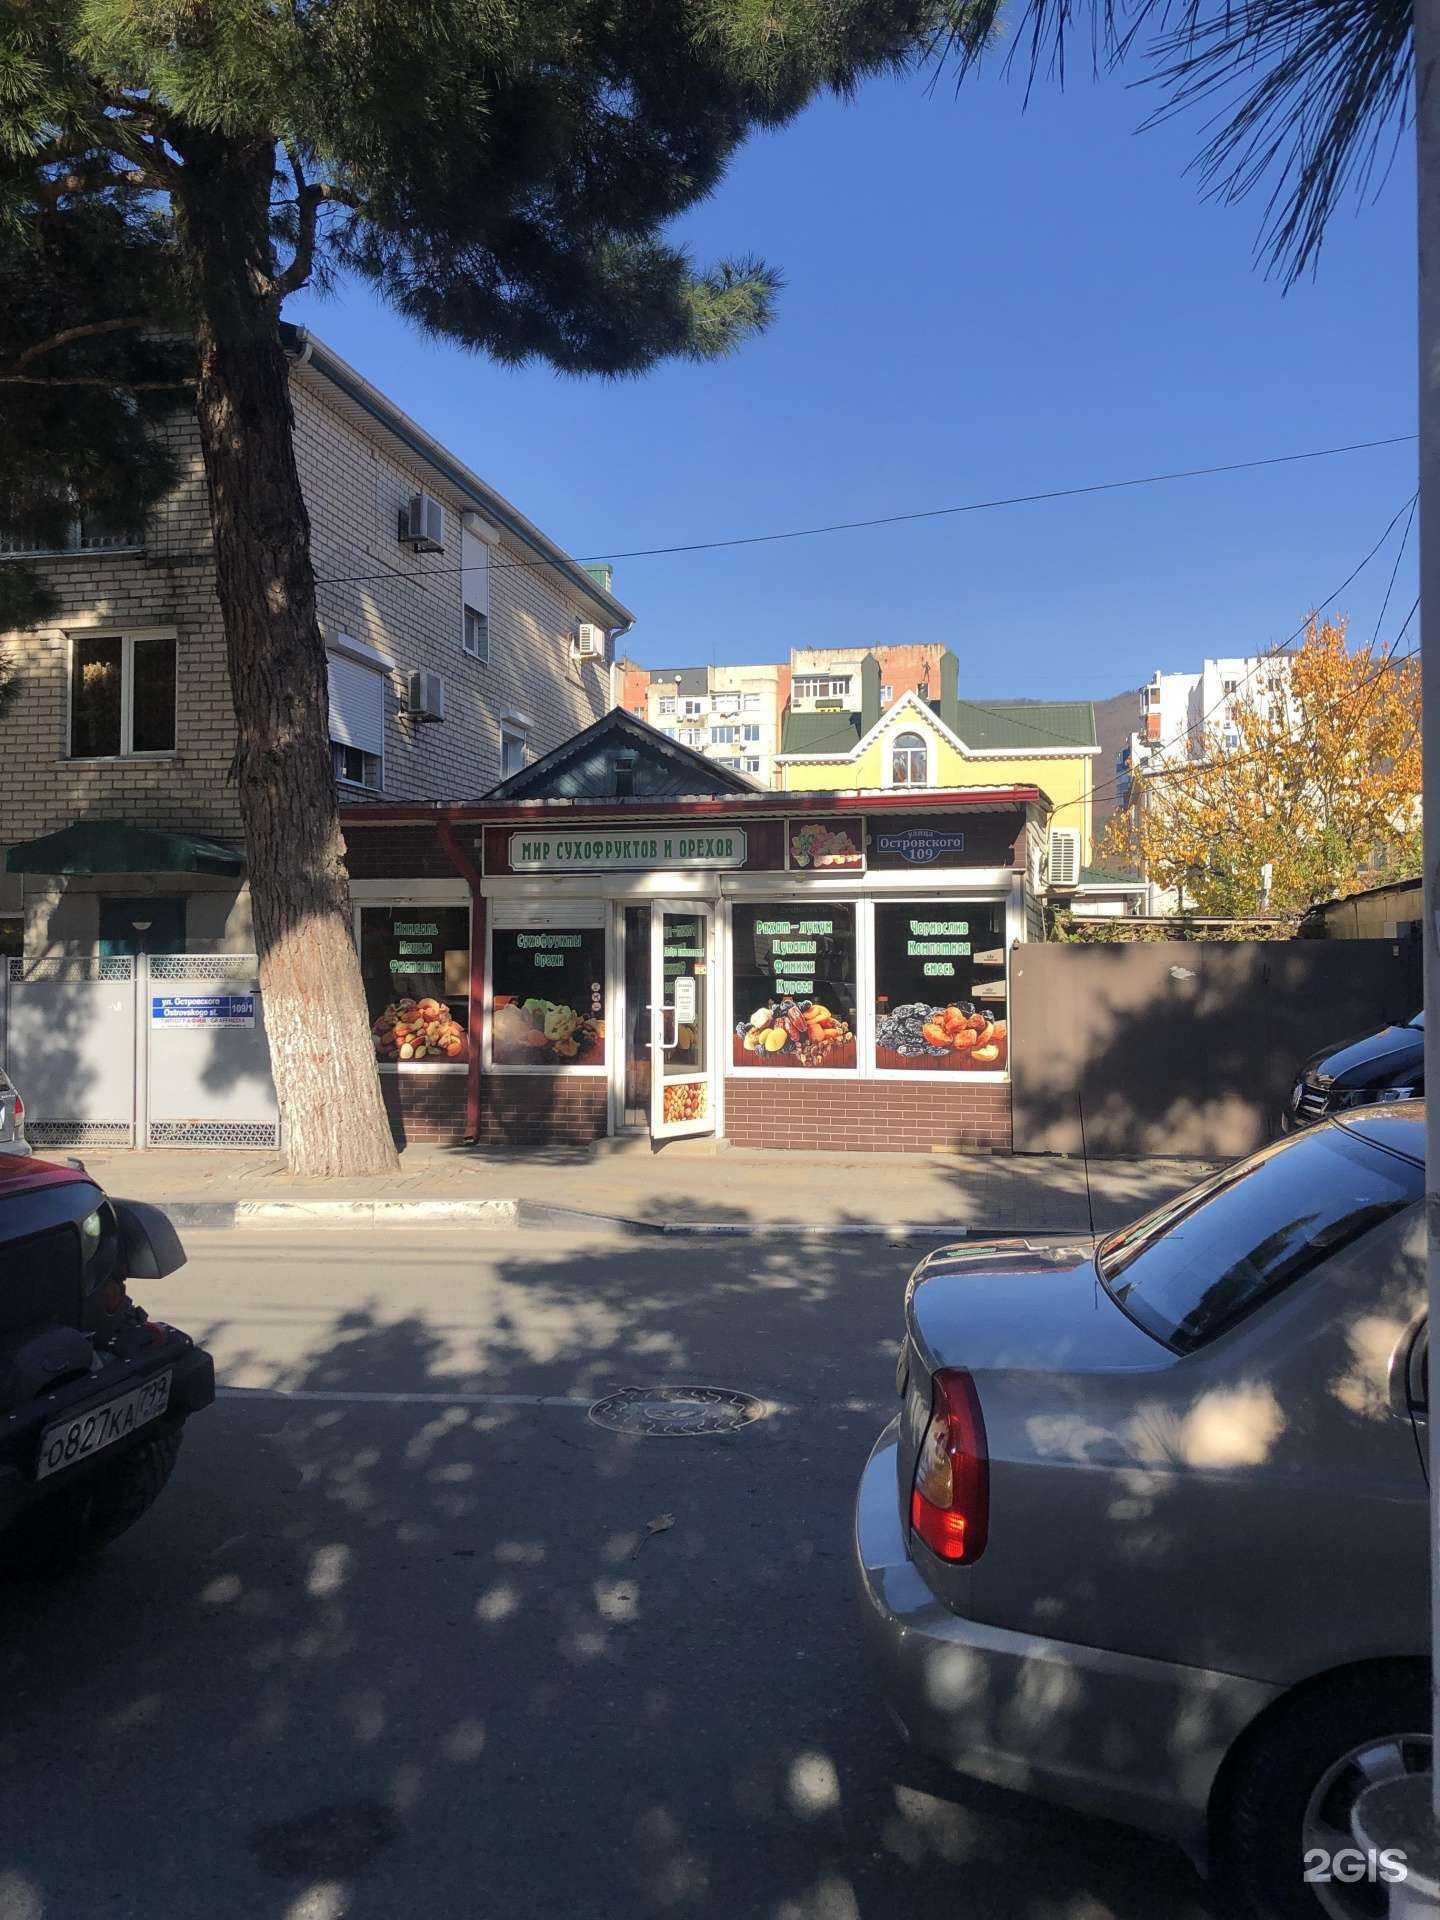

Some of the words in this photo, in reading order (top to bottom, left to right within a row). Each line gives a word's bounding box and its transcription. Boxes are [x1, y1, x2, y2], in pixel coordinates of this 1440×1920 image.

[521, 842, 550, 861] МИР
[556, 839, 658, 860] СУХОФРУКТОВ
[663, 839, 673, 858] И
[679, 838, 734, 858] ОРЕХОВ
[880, 838, 961, 850] Островского
[910, 848, 933, 860] 109
[910, 920, 969, 936] Чернослив
[517, 934, 581, 948] Сухофрукты
[773, 940, 816, 954] Цукаты
[907, 941, 971, 955] Компотная
[774, 960, 815, 974] Финики
[924, 963, 955, 976] смесь
[776, 979, 813, 994] Курага
[163, 1008, 208, 1017] Ostrovskogo
[231, 1003, 253, 1013] 109/1
